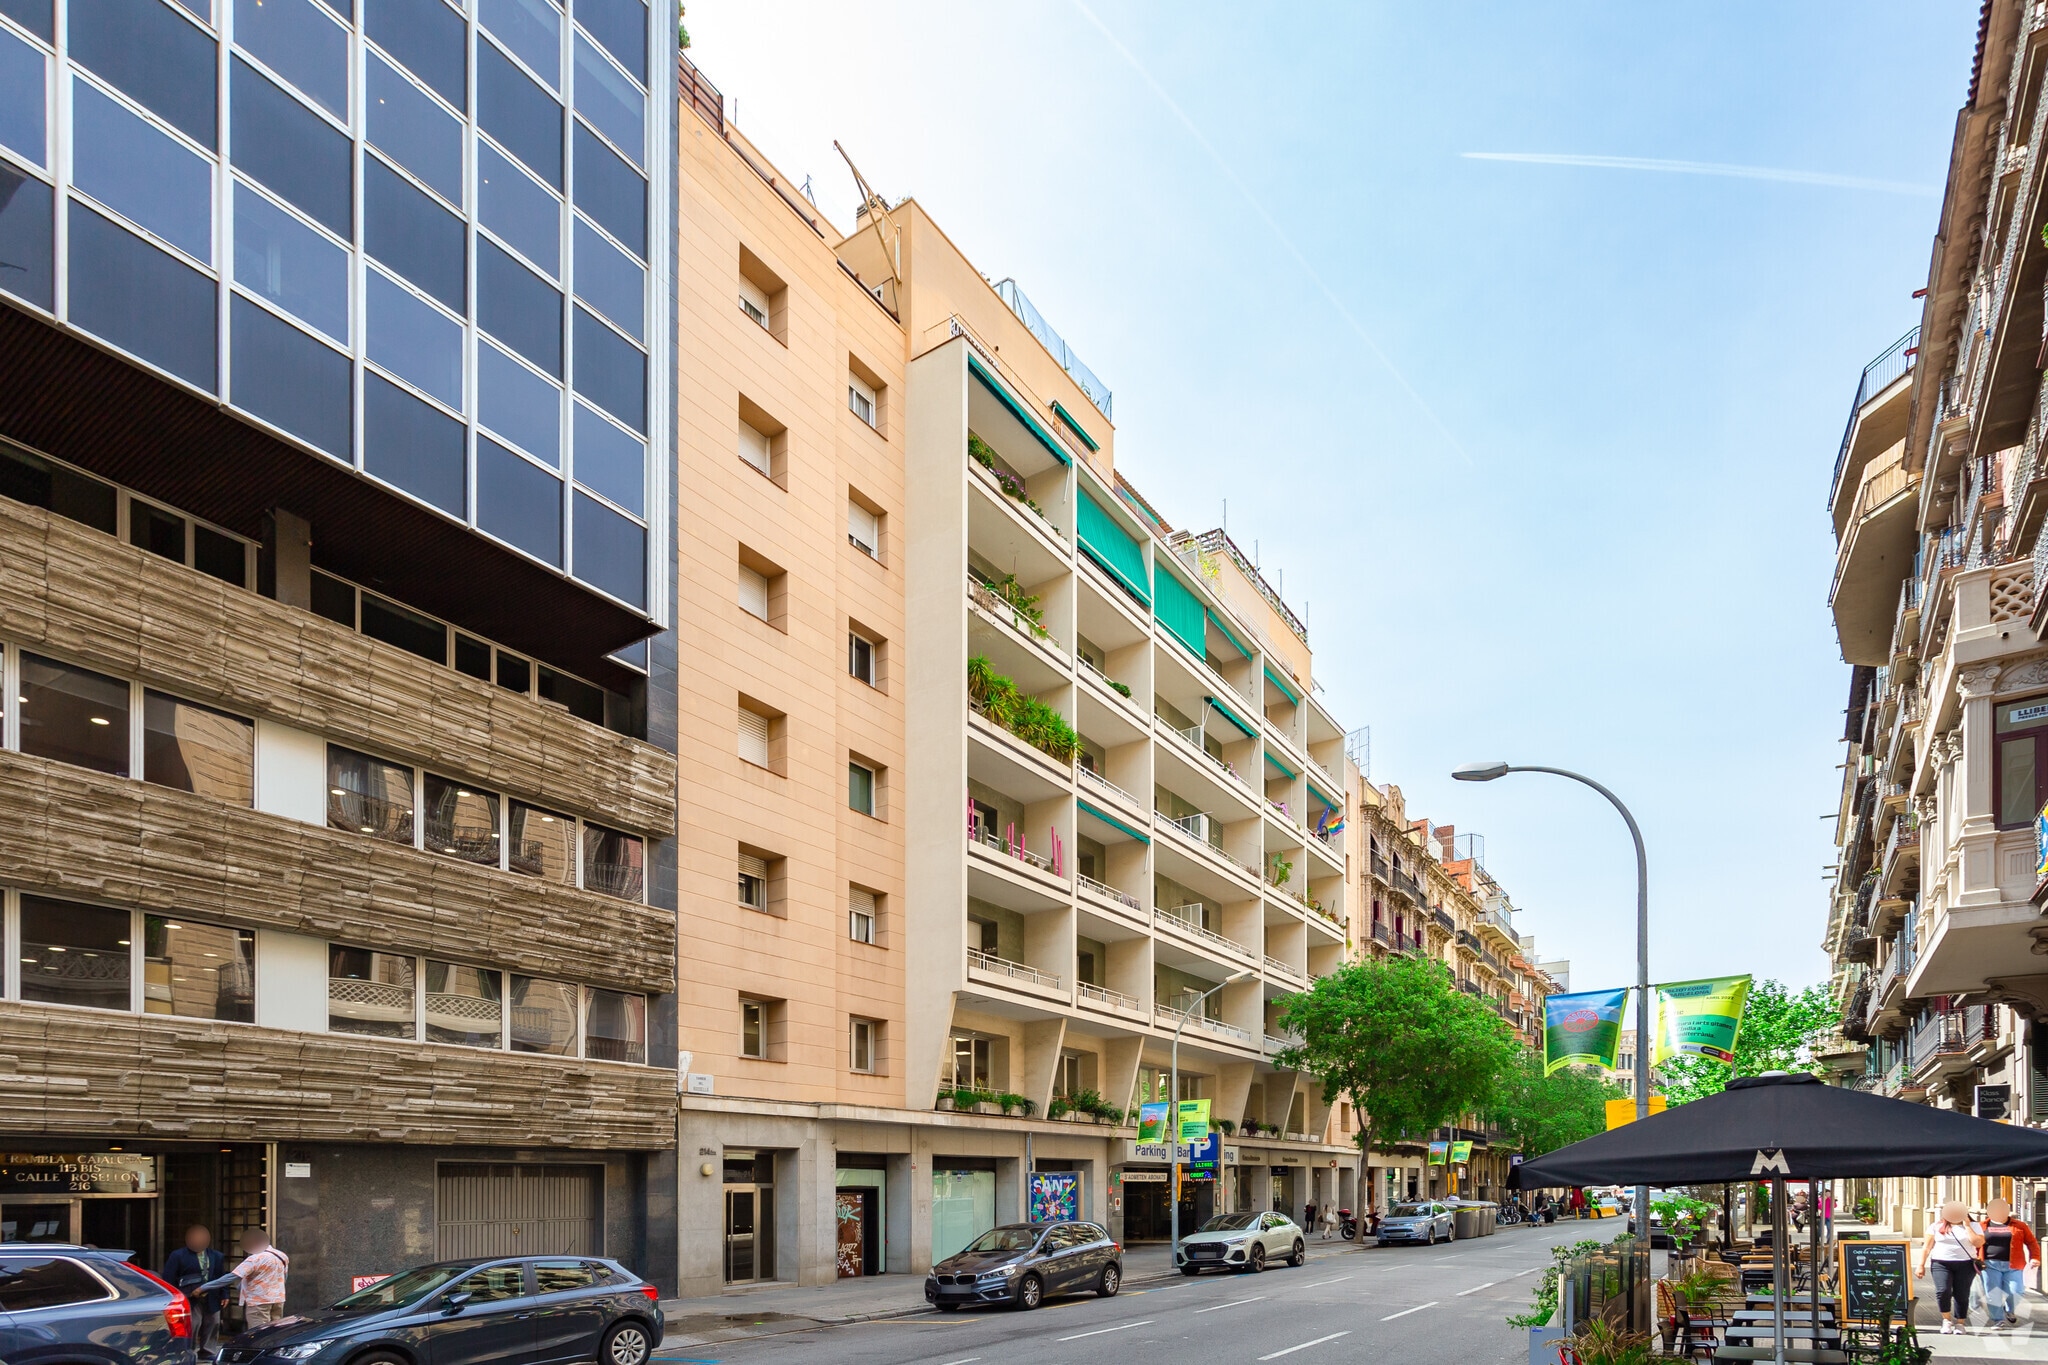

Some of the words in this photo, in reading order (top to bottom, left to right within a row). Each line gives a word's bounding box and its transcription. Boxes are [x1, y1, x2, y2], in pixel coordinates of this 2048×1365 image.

[2018, 706, 2048, 716] LLIBE
[1663, 985, 1711, 993] IBLIOTEQUES
[1135, 1144, 1167, 1160] Parking
[1177, 1146, 1190, 1158] Bar
[1223, 1149, 1234, 1162] ing
[10, 1155, 66, 1164] RAMBLA
[59, 1163, 77, 1173] 115
[80, 1163, 101, 1173] BIS
[15, 1173, 60, 1182] CALLE
[69, 1181, 91, 1191] 216
[1033, 1179, 1073, 1192] SANT
